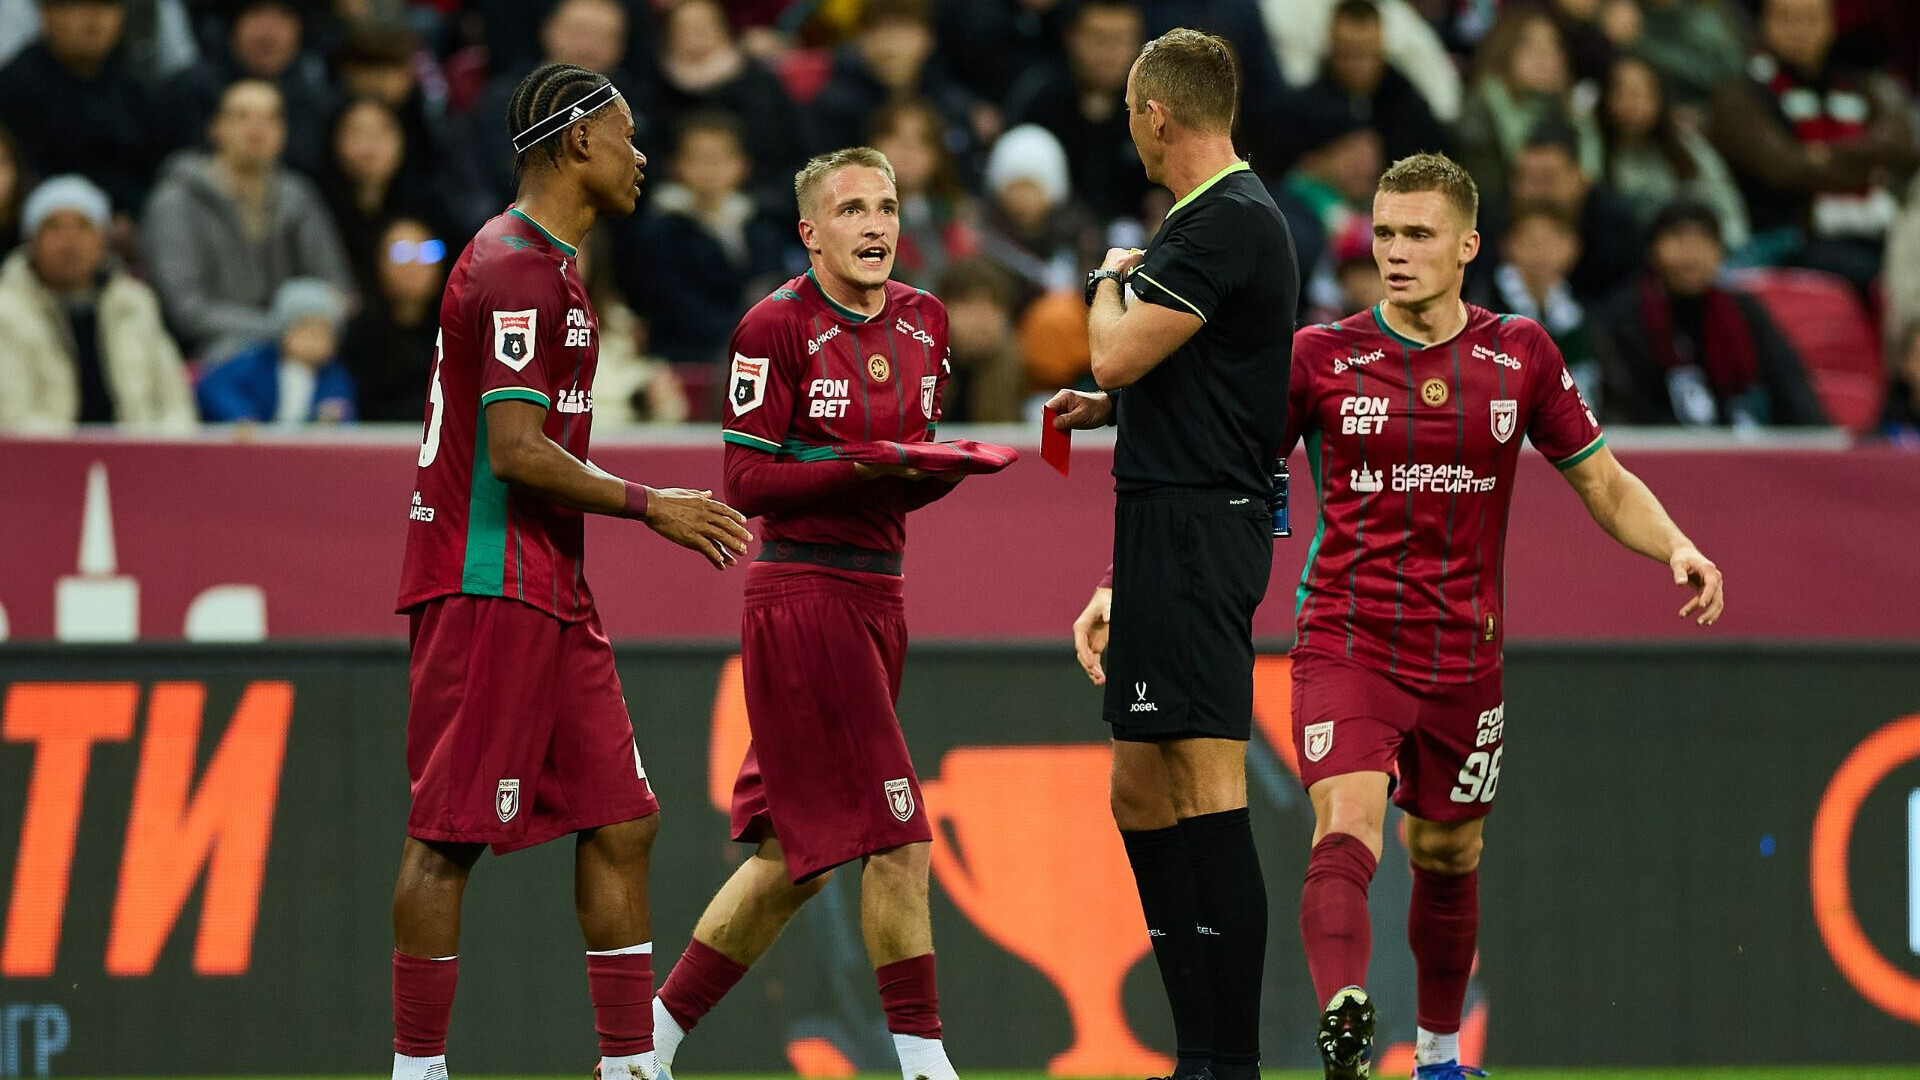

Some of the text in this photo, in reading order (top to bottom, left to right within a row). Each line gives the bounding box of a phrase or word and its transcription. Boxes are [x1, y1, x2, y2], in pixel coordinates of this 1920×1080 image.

[567, 308, 587, 328] FON
[565, 329, 590, 347] BET
[808, 379, 849, 398] FON
[808, 399, 851, 418] BET
[1340, 396, 1390, 416] FON
[1341, 415, 1389, 435] BET
[1392, 463, 1474, 479] КАЗАНЬ
[1391, 476, 1497, 493] ОРГСИНТЕЗ
[1476, 701, 1504, 729] FON
[1449, 742, 1503, 803] 98
[0, 681, 294, 977] ТИ
[0, 1003, 70, 1078] ГР
